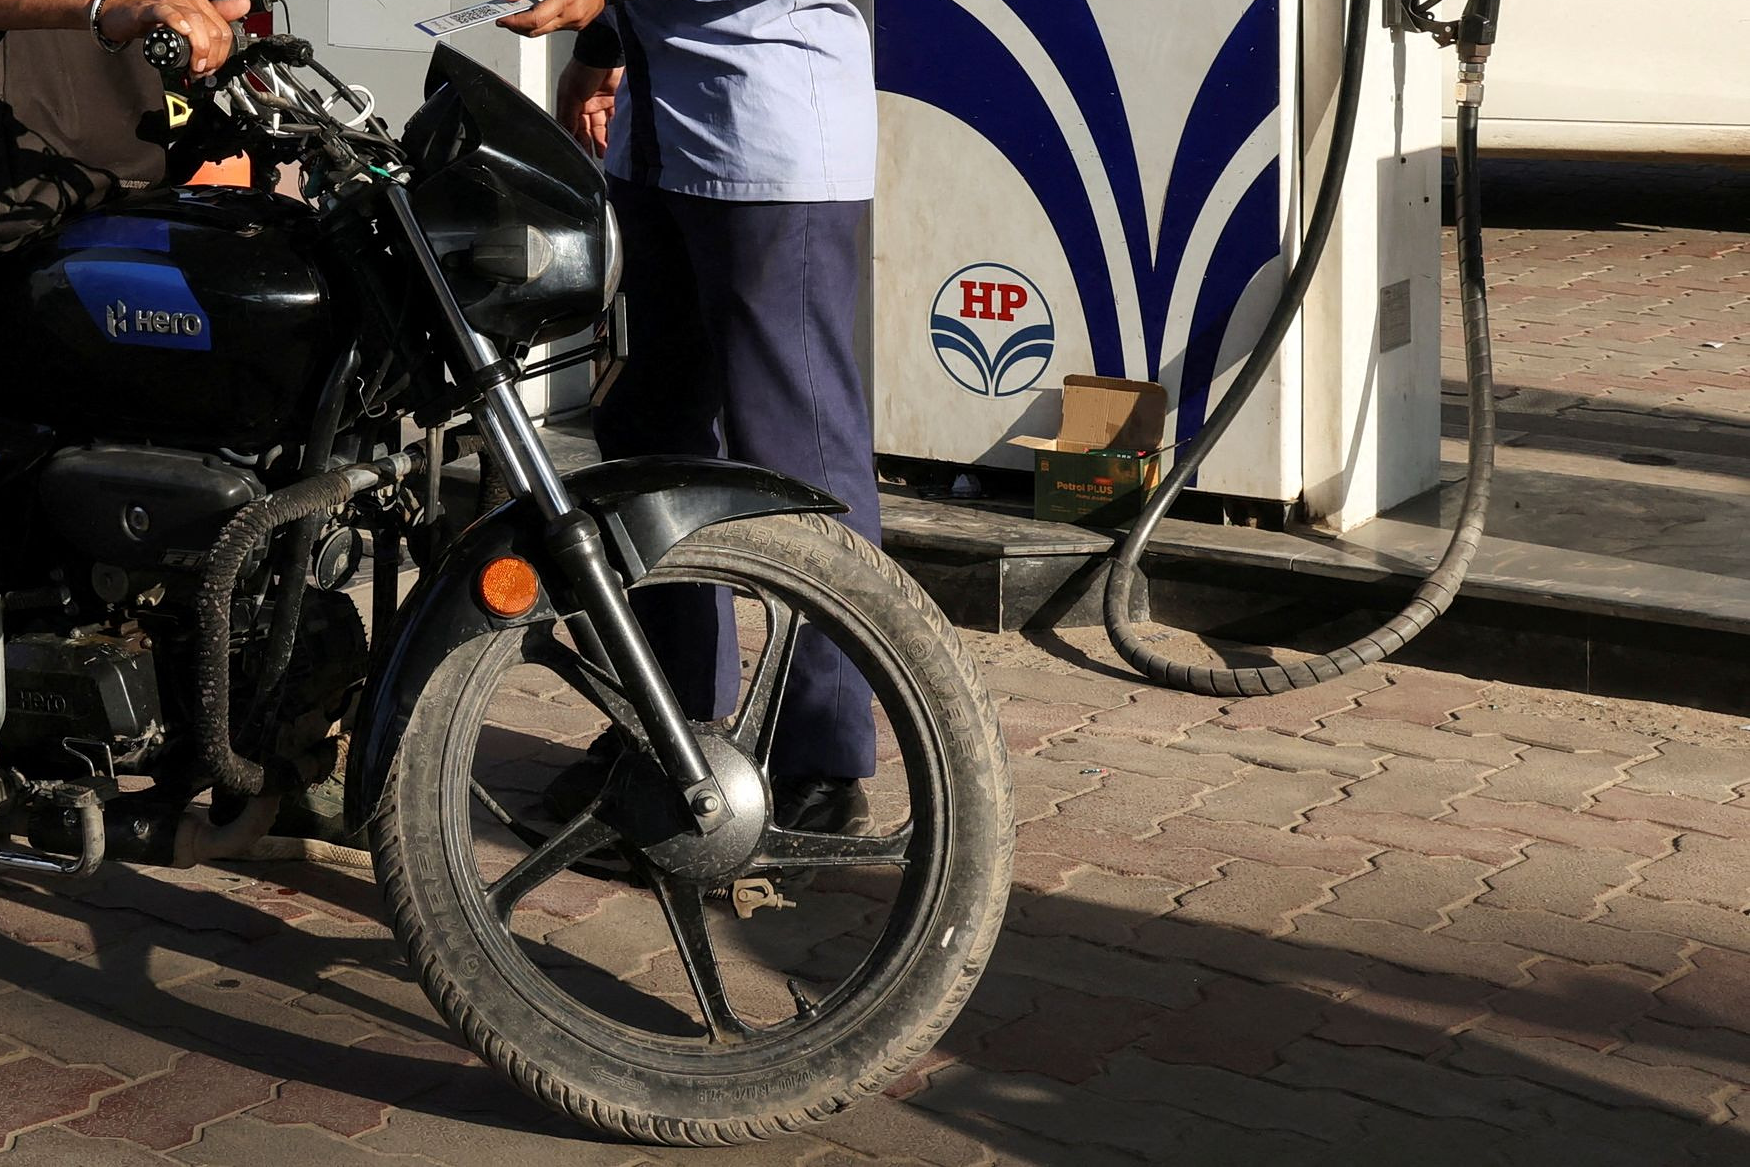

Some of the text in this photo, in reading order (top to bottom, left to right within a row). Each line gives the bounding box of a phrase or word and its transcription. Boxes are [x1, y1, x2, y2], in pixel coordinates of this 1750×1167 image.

[958, 279, 1029, 322] HP
[135, 309, 203, 336] Hero
[1056, 480, 1085, 492] Petrol
[1087, 483, 1114, 495] PLUS
